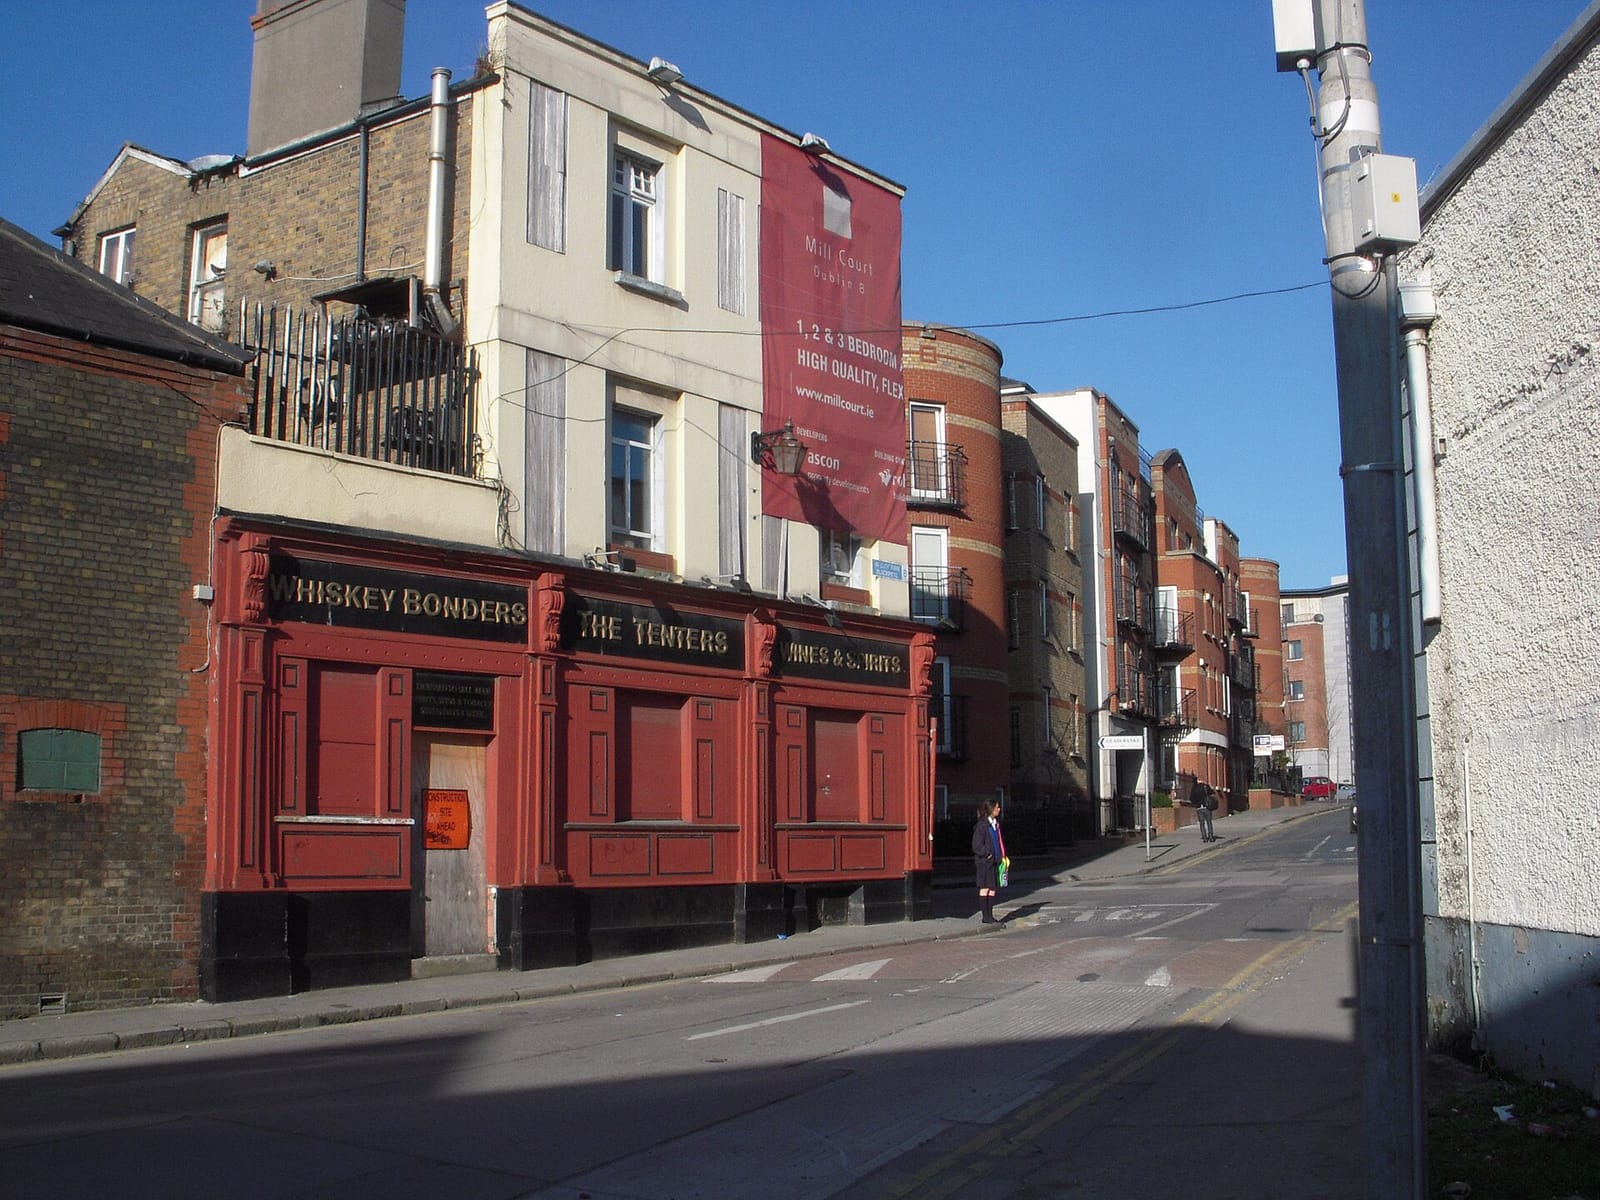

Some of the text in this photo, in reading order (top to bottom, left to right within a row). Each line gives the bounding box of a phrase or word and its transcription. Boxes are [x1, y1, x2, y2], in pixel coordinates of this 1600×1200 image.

[805, 235, 873, 277] Mill Court
[813, 265, 865, 295] Dublin 8
[812, 324, 820, 341] 2
[824, 328, 834, 344] &
[837, 333, 845, 348] 3
[848, 335, 897, 368] BEDROOM
[797, 348, 828, 372] HIGH
[832, 359, 879, 393] QUALITY,
[882, 377, 904, 401] FLEX
[795, 385, 875, 419] www.millcourt.ie
[796, 426, 828, 443] DEVELOPERS
[807, 452, 840, 471] ascon
[269, 573, 528, 626] WHISKEY BONDERS
[577, 609, 729, 656] THE TENTERS
[779, 640, 829, 665] WINES
[832, 648, 843, 667] &
[436, 821, 456, 831] AHEAD
[439, 807, 453, 817] SITE
